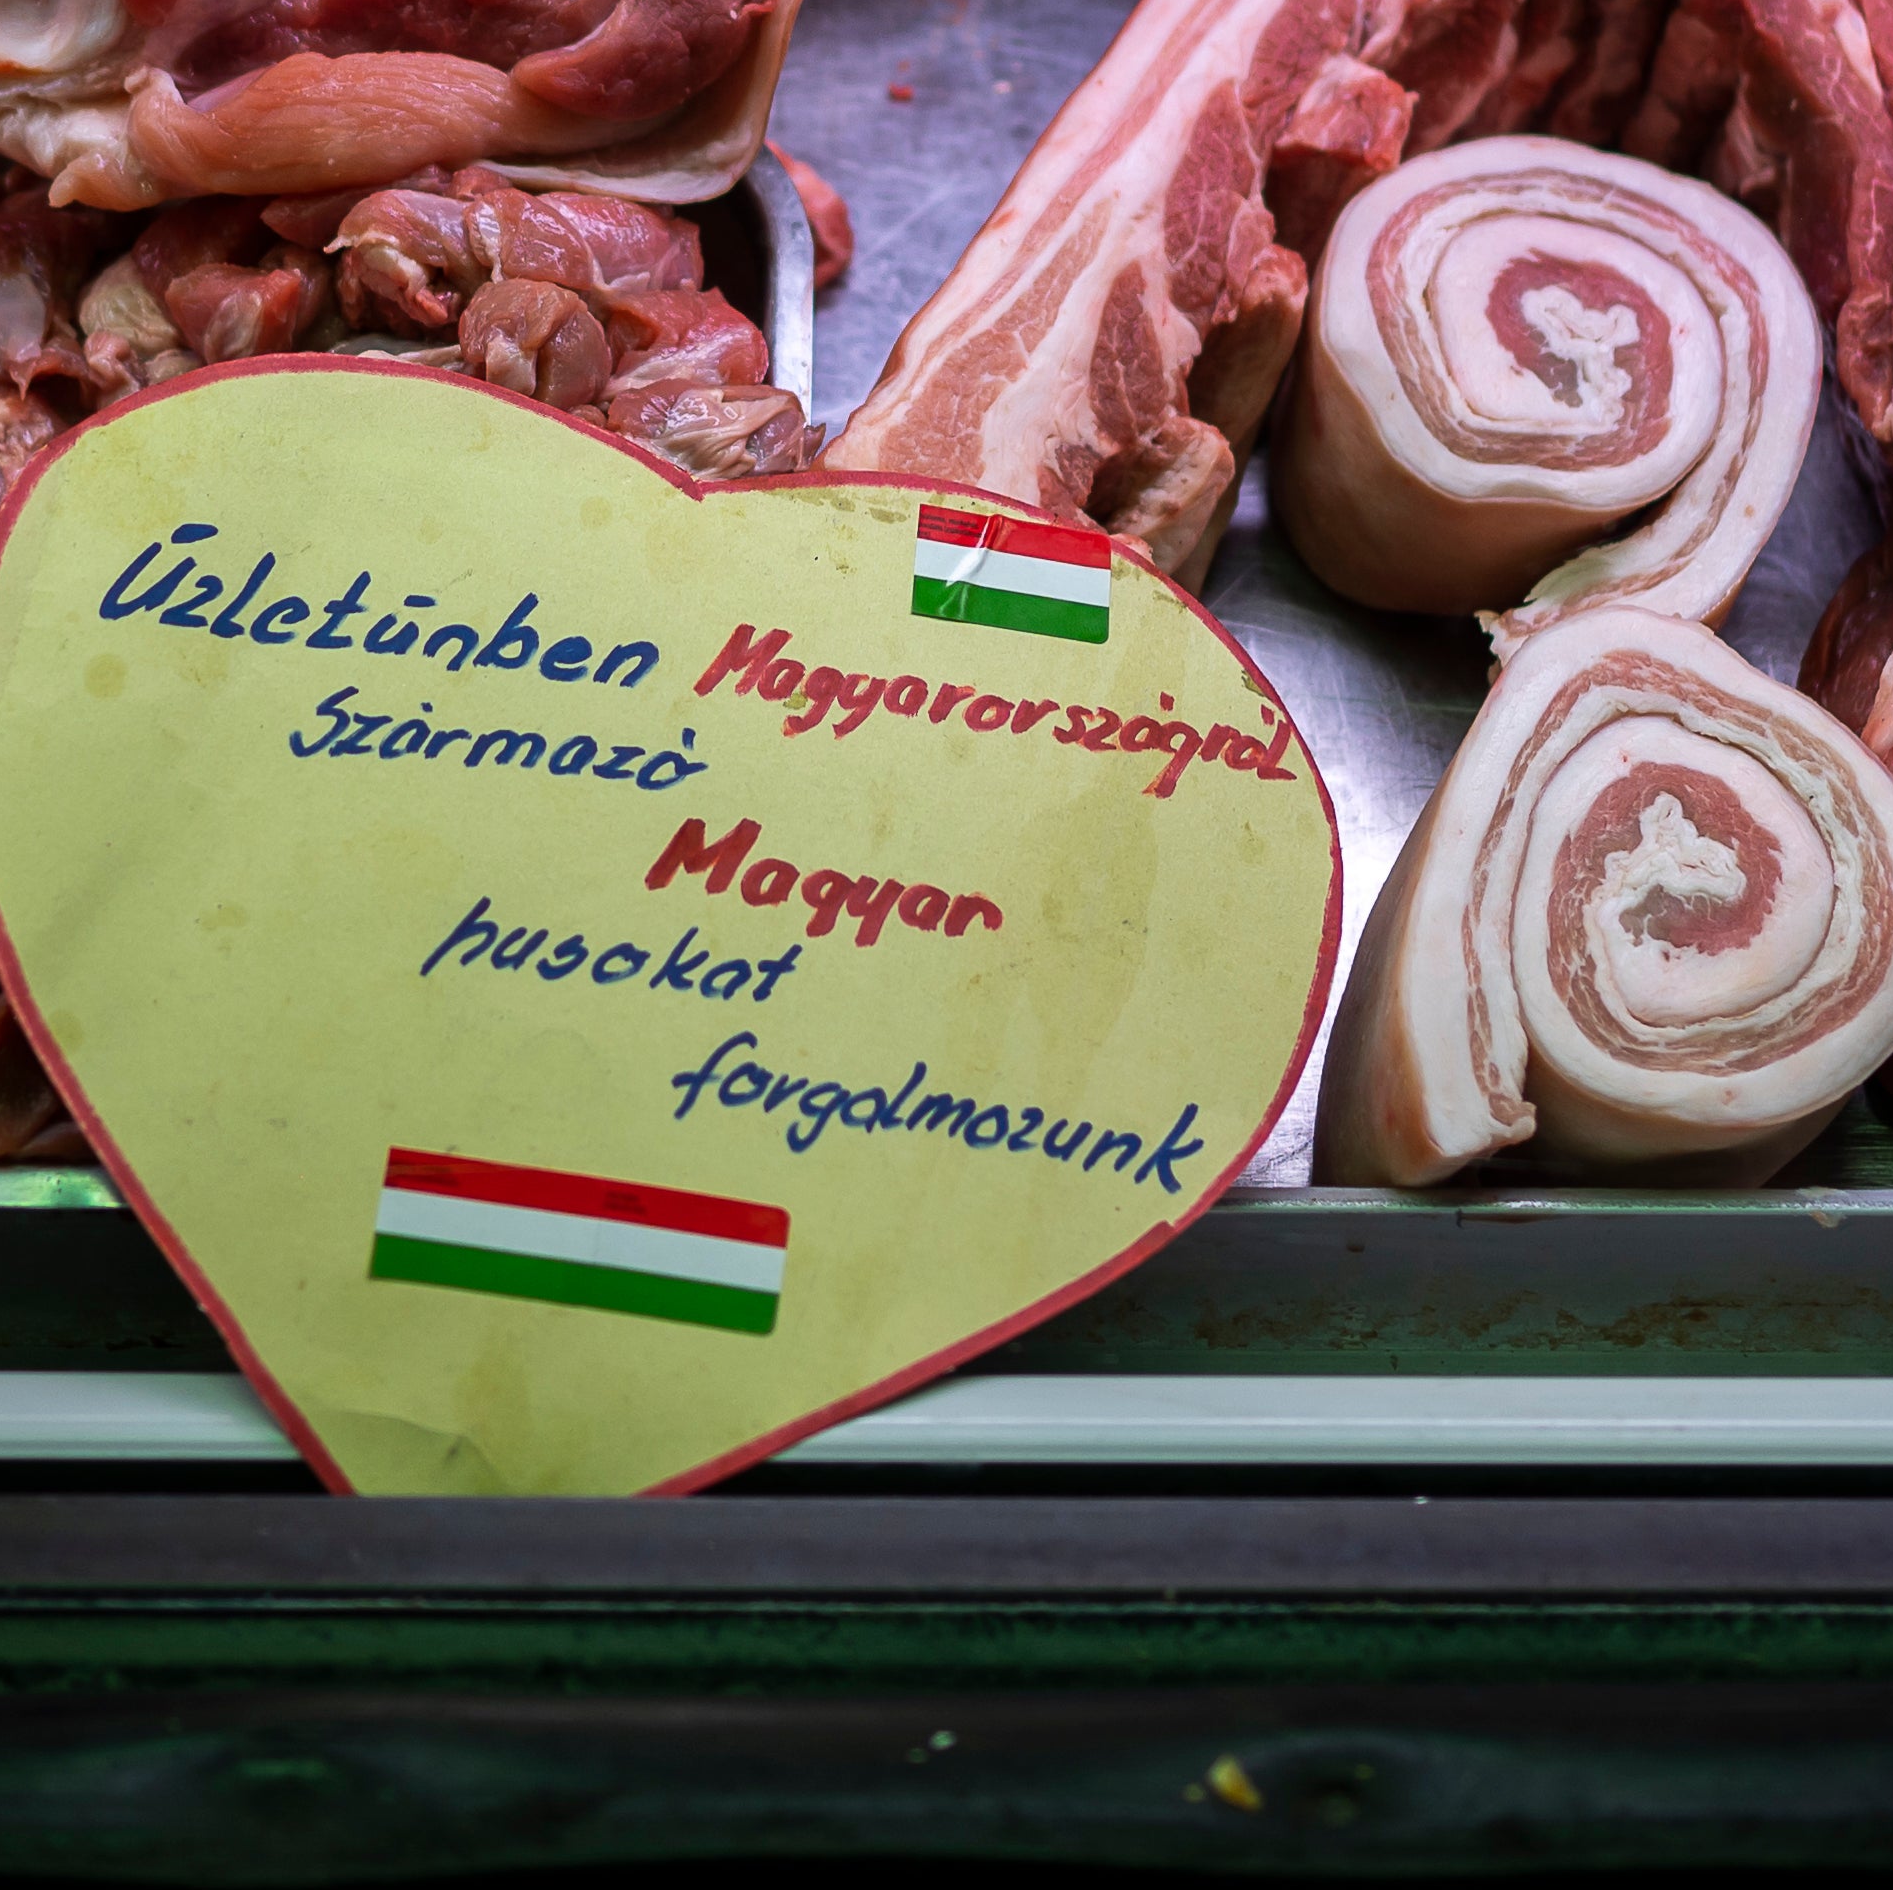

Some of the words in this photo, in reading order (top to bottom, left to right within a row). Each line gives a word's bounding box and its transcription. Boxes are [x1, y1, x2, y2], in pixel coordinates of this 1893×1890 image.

[645, 818, 1003, 947] Magyar
[421, 896, 802, 1000] husokat
[672, 1032, 1204, 1194] forgalmazunk
